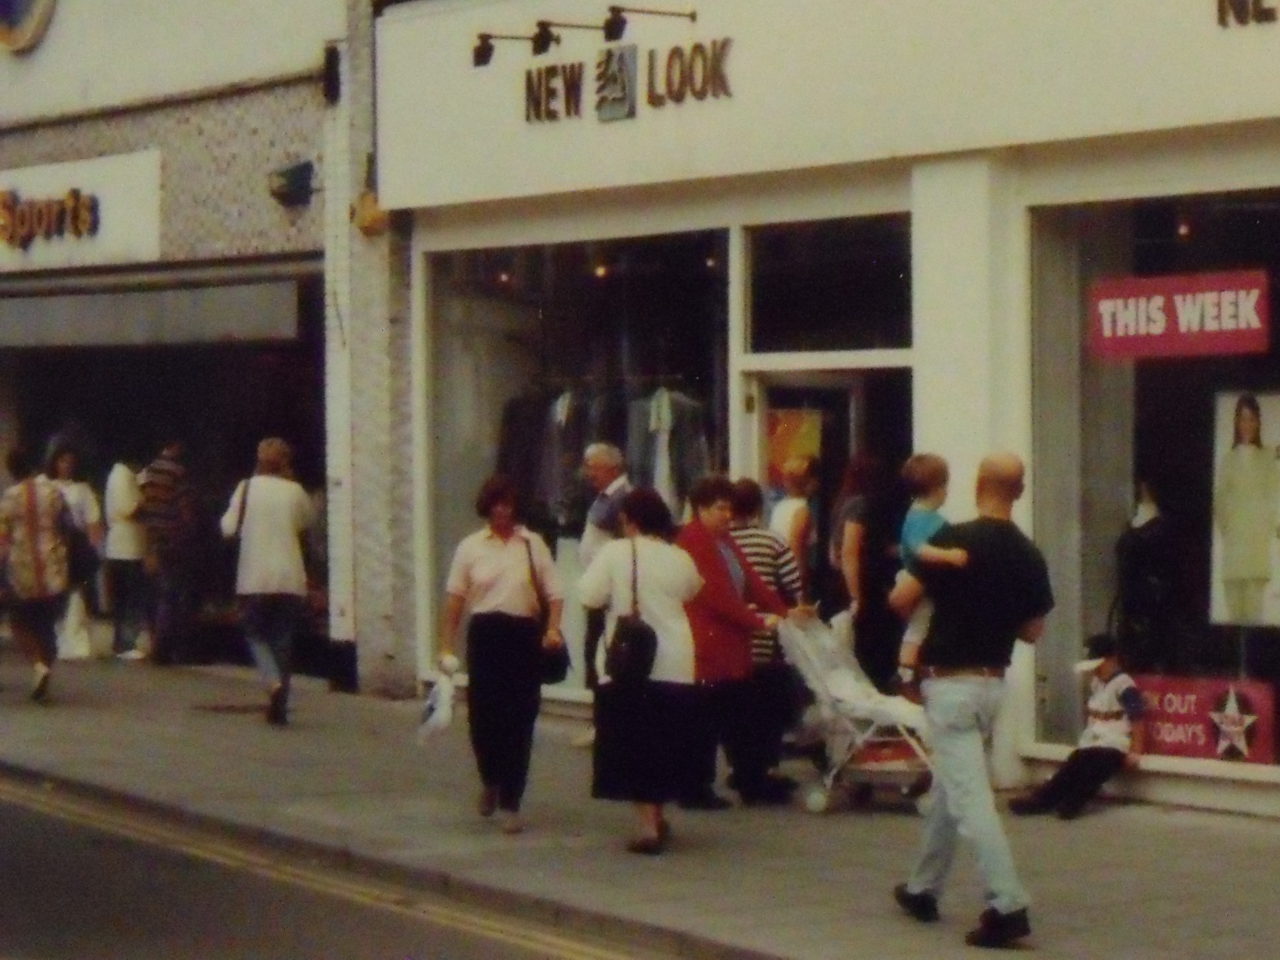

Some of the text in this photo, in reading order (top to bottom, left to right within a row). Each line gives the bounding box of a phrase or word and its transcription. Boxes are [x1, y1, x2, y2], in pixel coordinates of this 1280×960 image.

[524, 36, 734, 124] NEW LOOK
[1098, 288, 1262, 338] THIS WEEK
[1163, 692, 1197, 715] OUT
